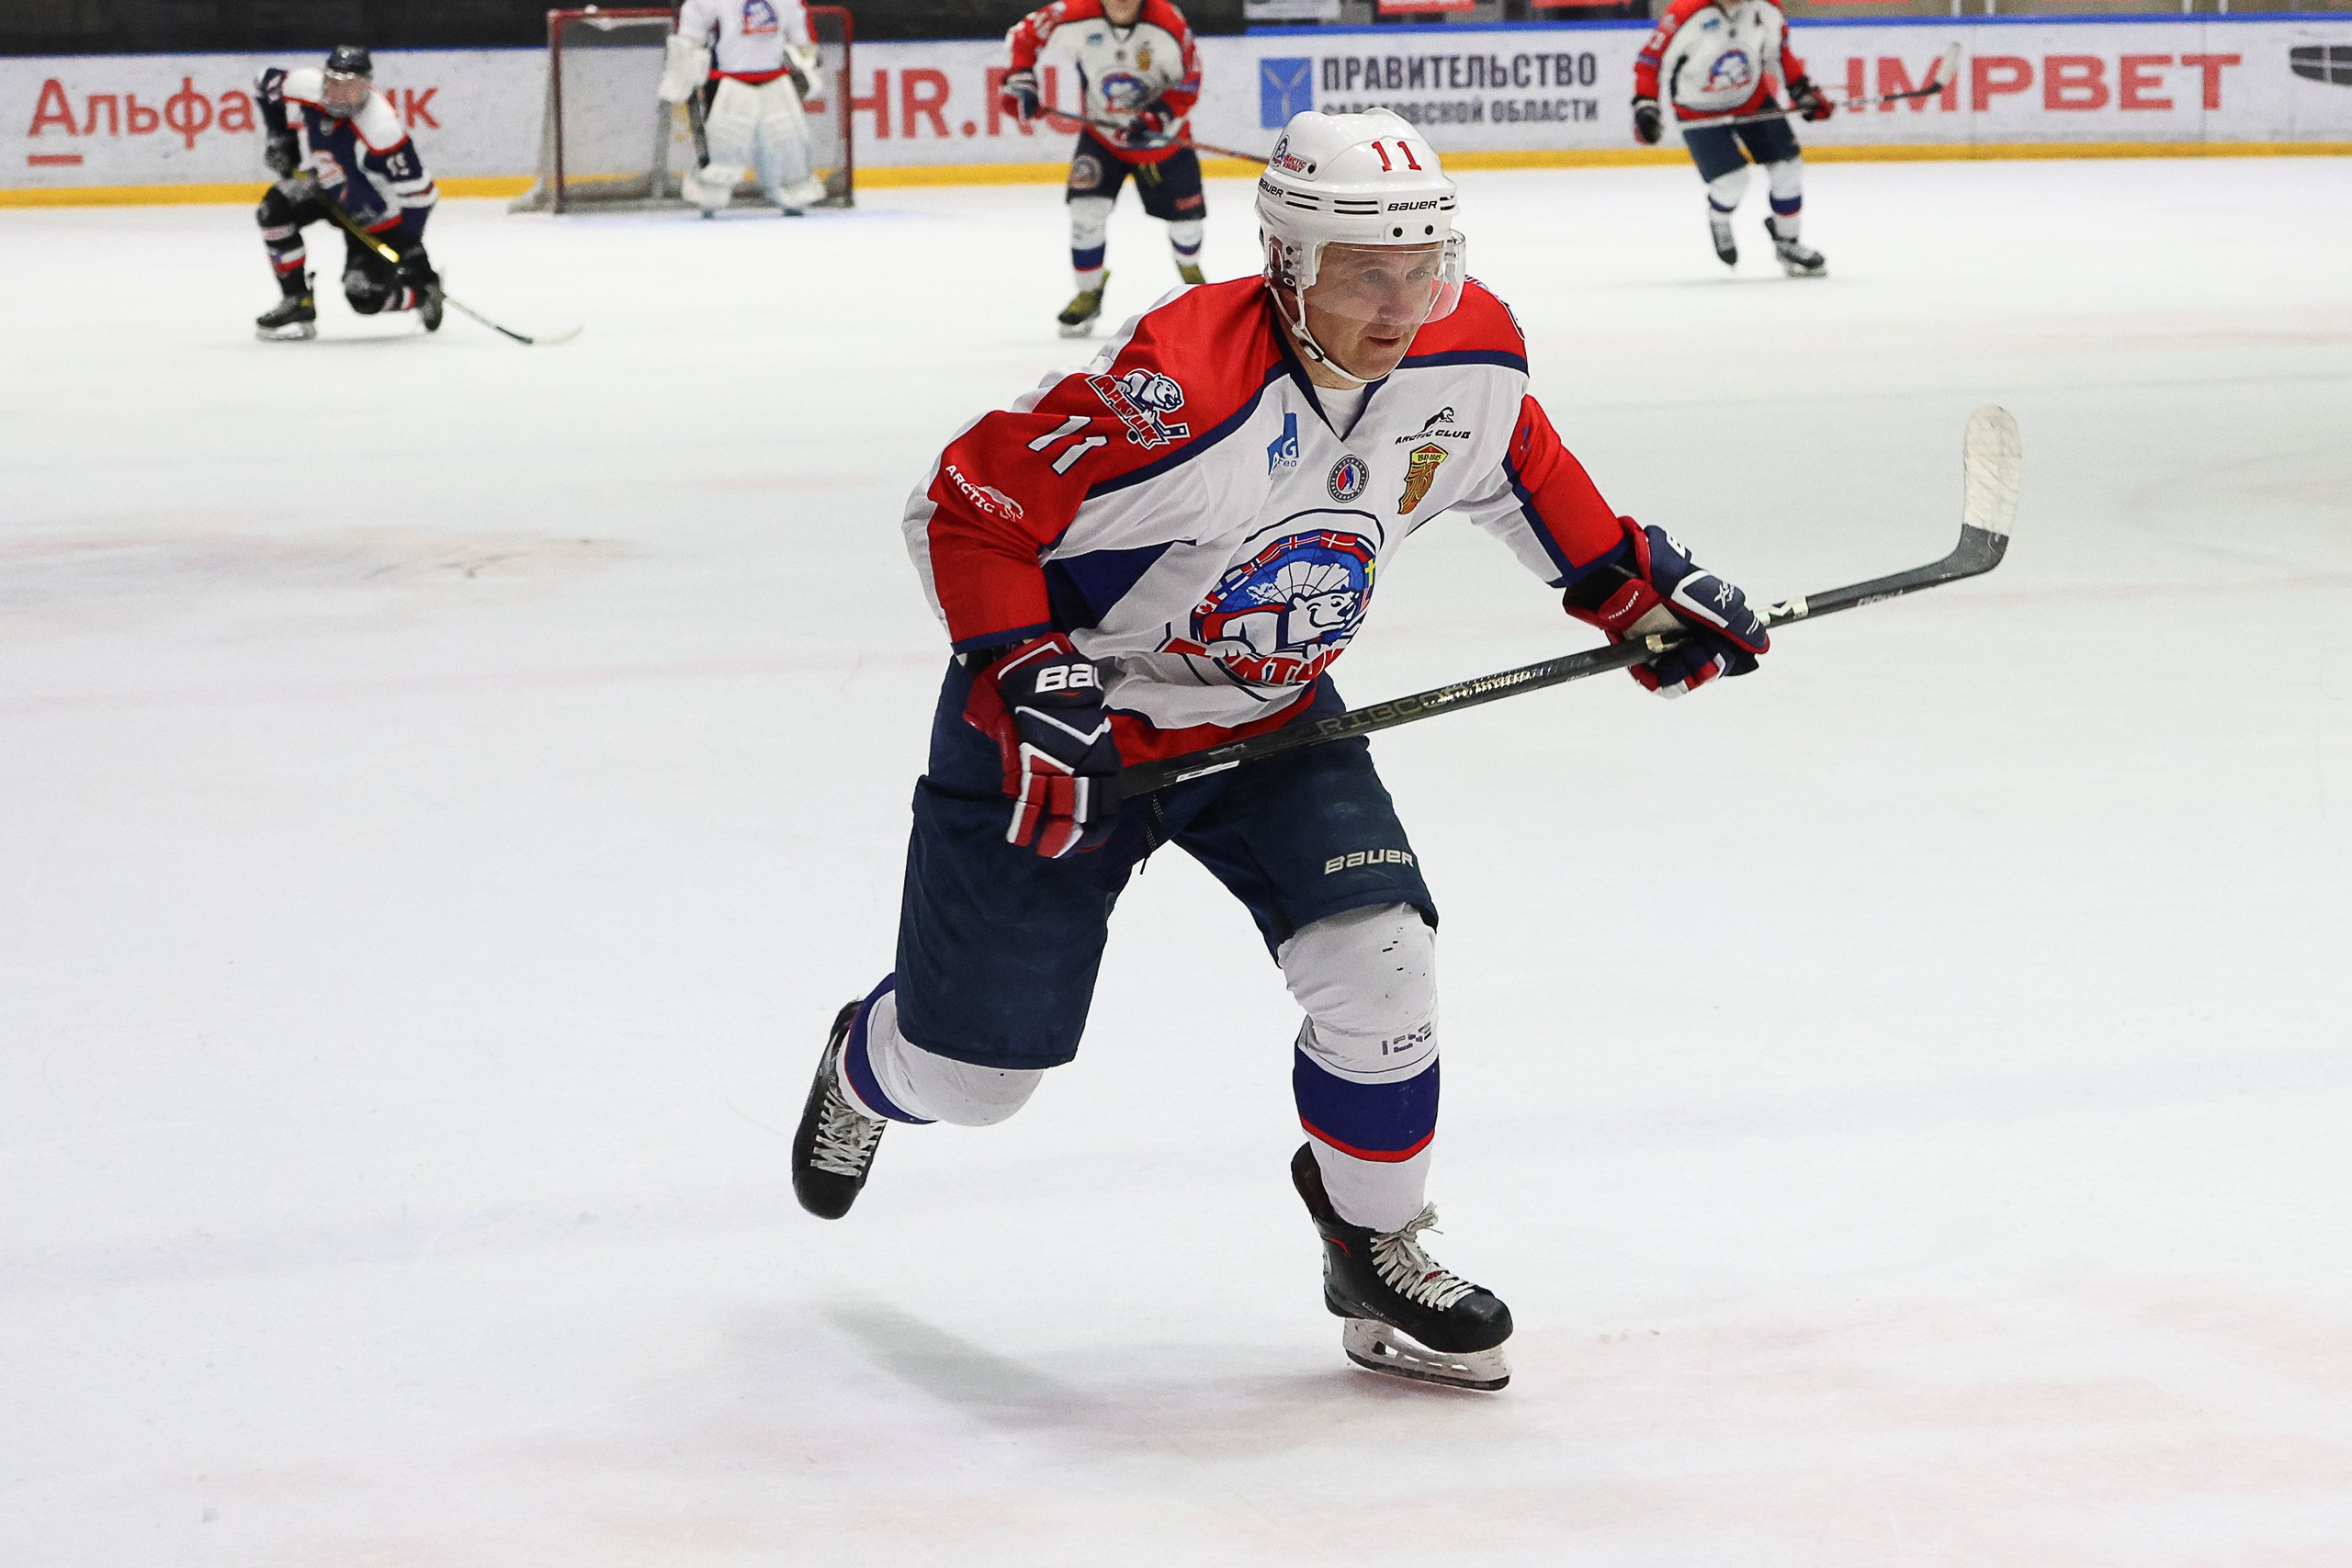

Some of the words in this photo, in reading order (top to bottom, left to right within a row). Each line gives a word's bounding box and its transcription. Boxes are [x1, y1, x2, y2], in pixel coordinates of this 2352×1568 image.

[1321, 52, 1597, 90] ПРАВИТЕЛЬСТВО
[1490, 98, 1598, 123] ОБЛАСТИ
[1372, 141, 1422, 173] 11
[1387, 200, 1438, 211] BAUER
[1027, 415, 1108, 476] 11
[1435, 429, 1471, 439] CLUB
[945, 465, 995, 513] ARCTIC
[1324, 849, 1414, 874] BAUER
